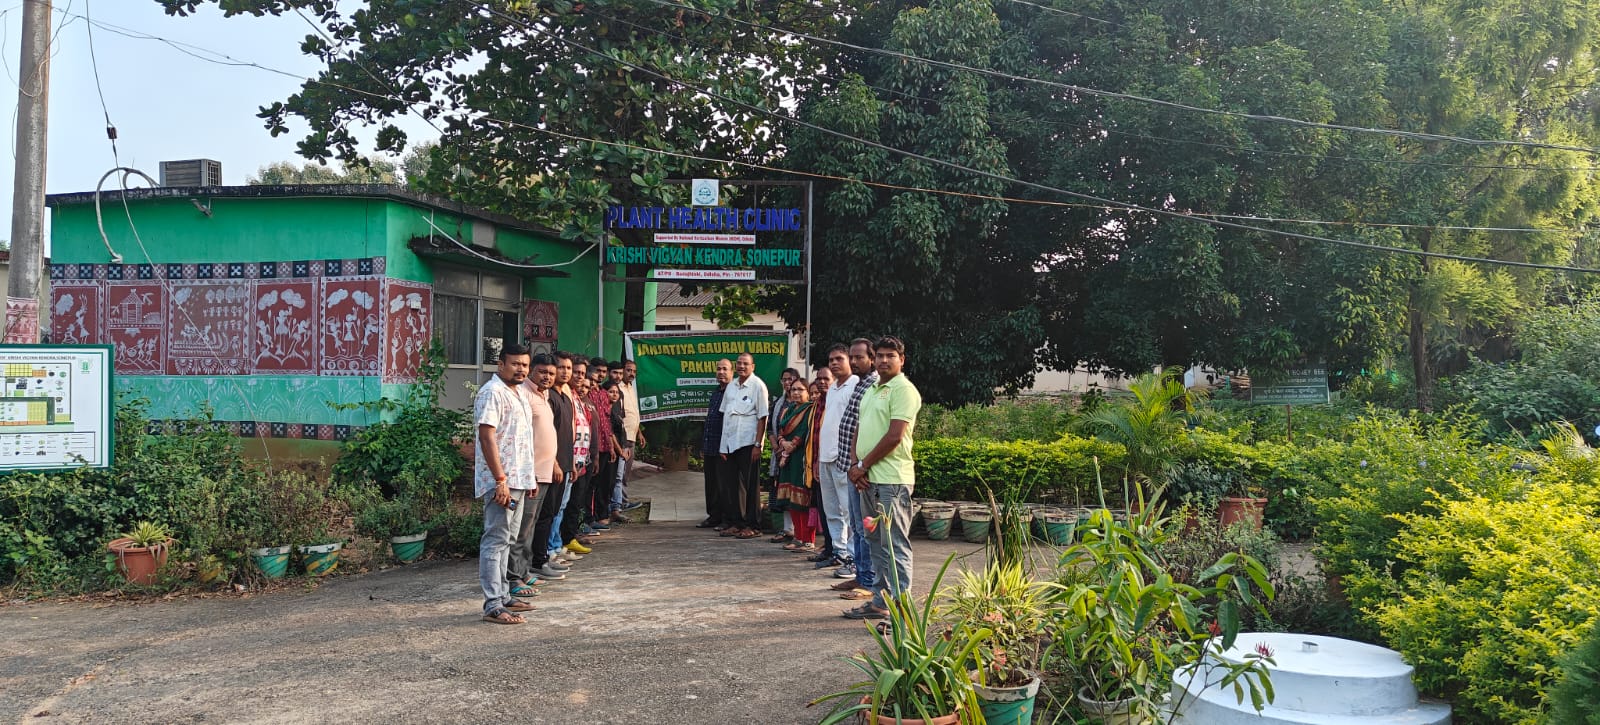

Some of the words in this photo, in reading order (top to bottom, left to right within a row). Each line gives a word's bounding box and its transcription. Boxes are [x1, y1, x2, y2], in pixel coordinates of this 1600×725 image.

[607, 206, 665, 229] PLANT
[668, 206, 739, 230] HEALTH
[744, 207, 800, 231] CLINIC
[607, 246, 647, 265] KRISHI
[650, 246, 692, 265] VIGYAN
[695, 247, 742, 266] KENDRA
[746, 248, 800, 267] SONEPUR
[637, 343, 696, 357] JANJATIYA
[697, 341, 745, 354] GAURAV
